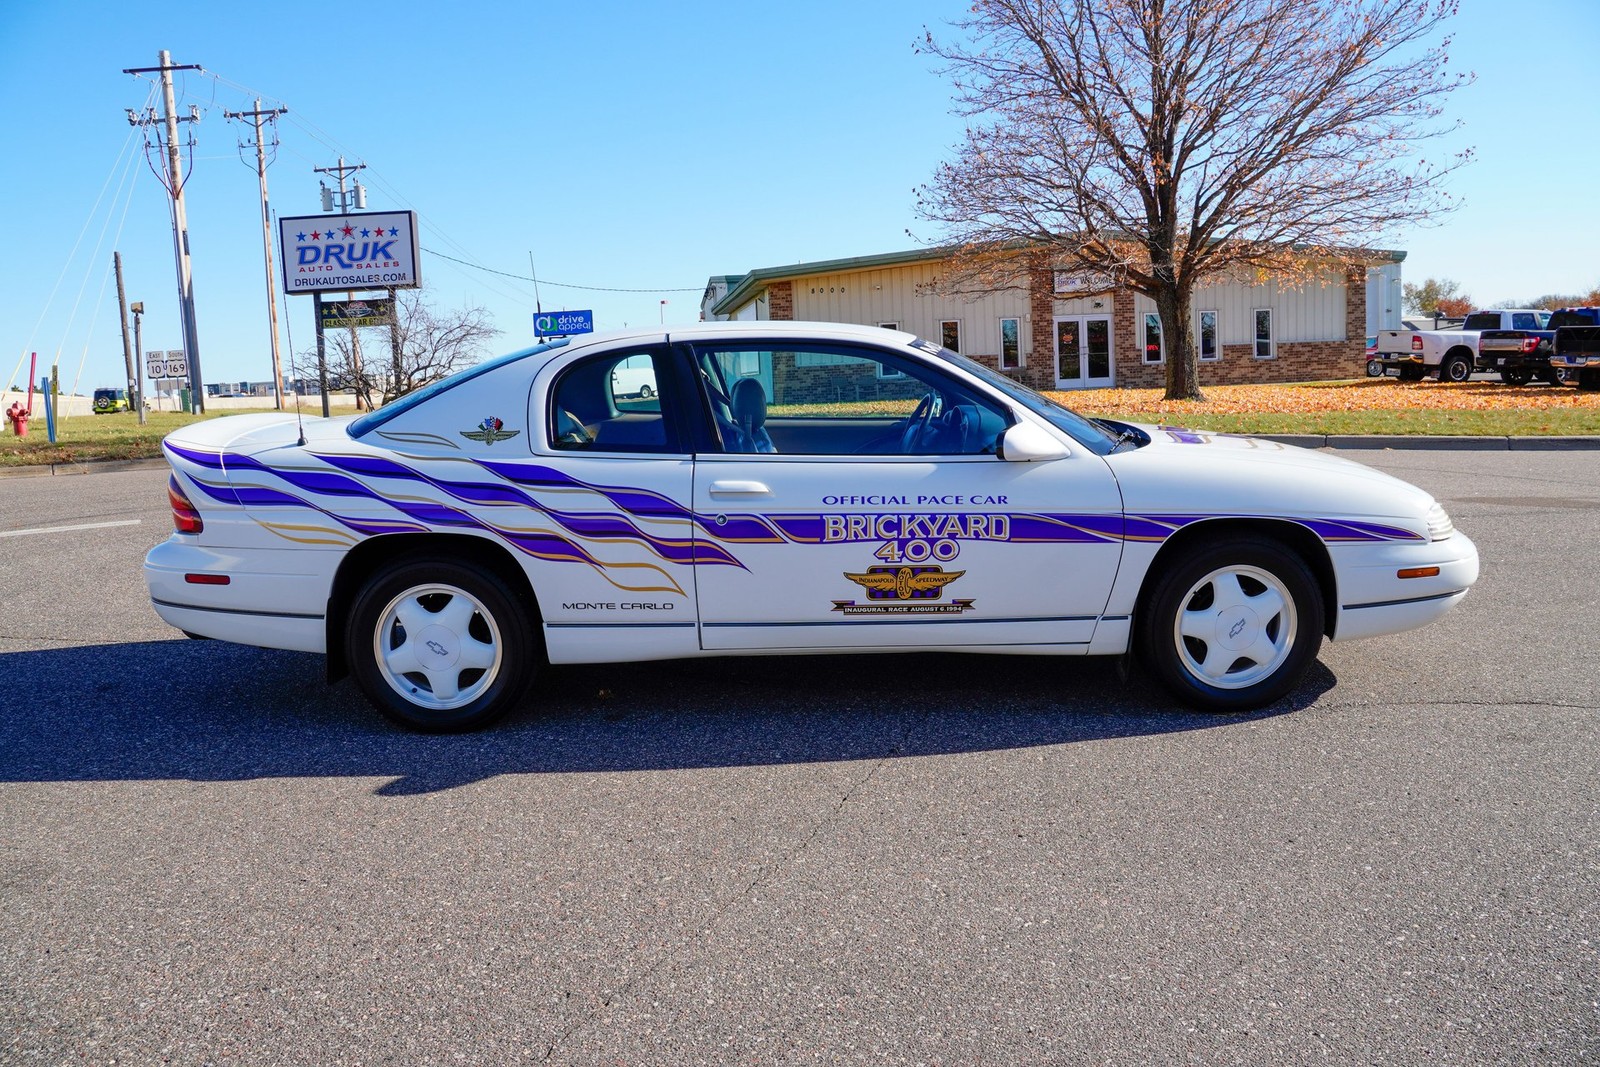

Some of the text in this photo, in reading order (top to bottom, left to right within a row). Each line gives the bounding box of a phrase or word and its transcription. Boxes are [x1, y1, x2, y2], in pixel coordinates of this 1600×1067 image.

[296, 240, 398, 269] DRUK
[299, 260, 400, 273] AUTO SALES
[295, 272, 406, 287] DRUKAUTOSALES.COM
[558, 315, 584, 324] drive
[558, 321, 591, 331] appeal
[149, 351, 160, 359] EAST
[151, 365, 161, 374] 10
[169, 363, 185, 373] 169
[822, 495, 1009, 505] OFFICIAL PACE CAR
[822, 514, 1010, 543] BRICKYARD
[874, 539, 960, 562] 400
[915, 575, 949, 583] SPEEDWAY
[562, 602, 674, 611] MONTE CARLO
